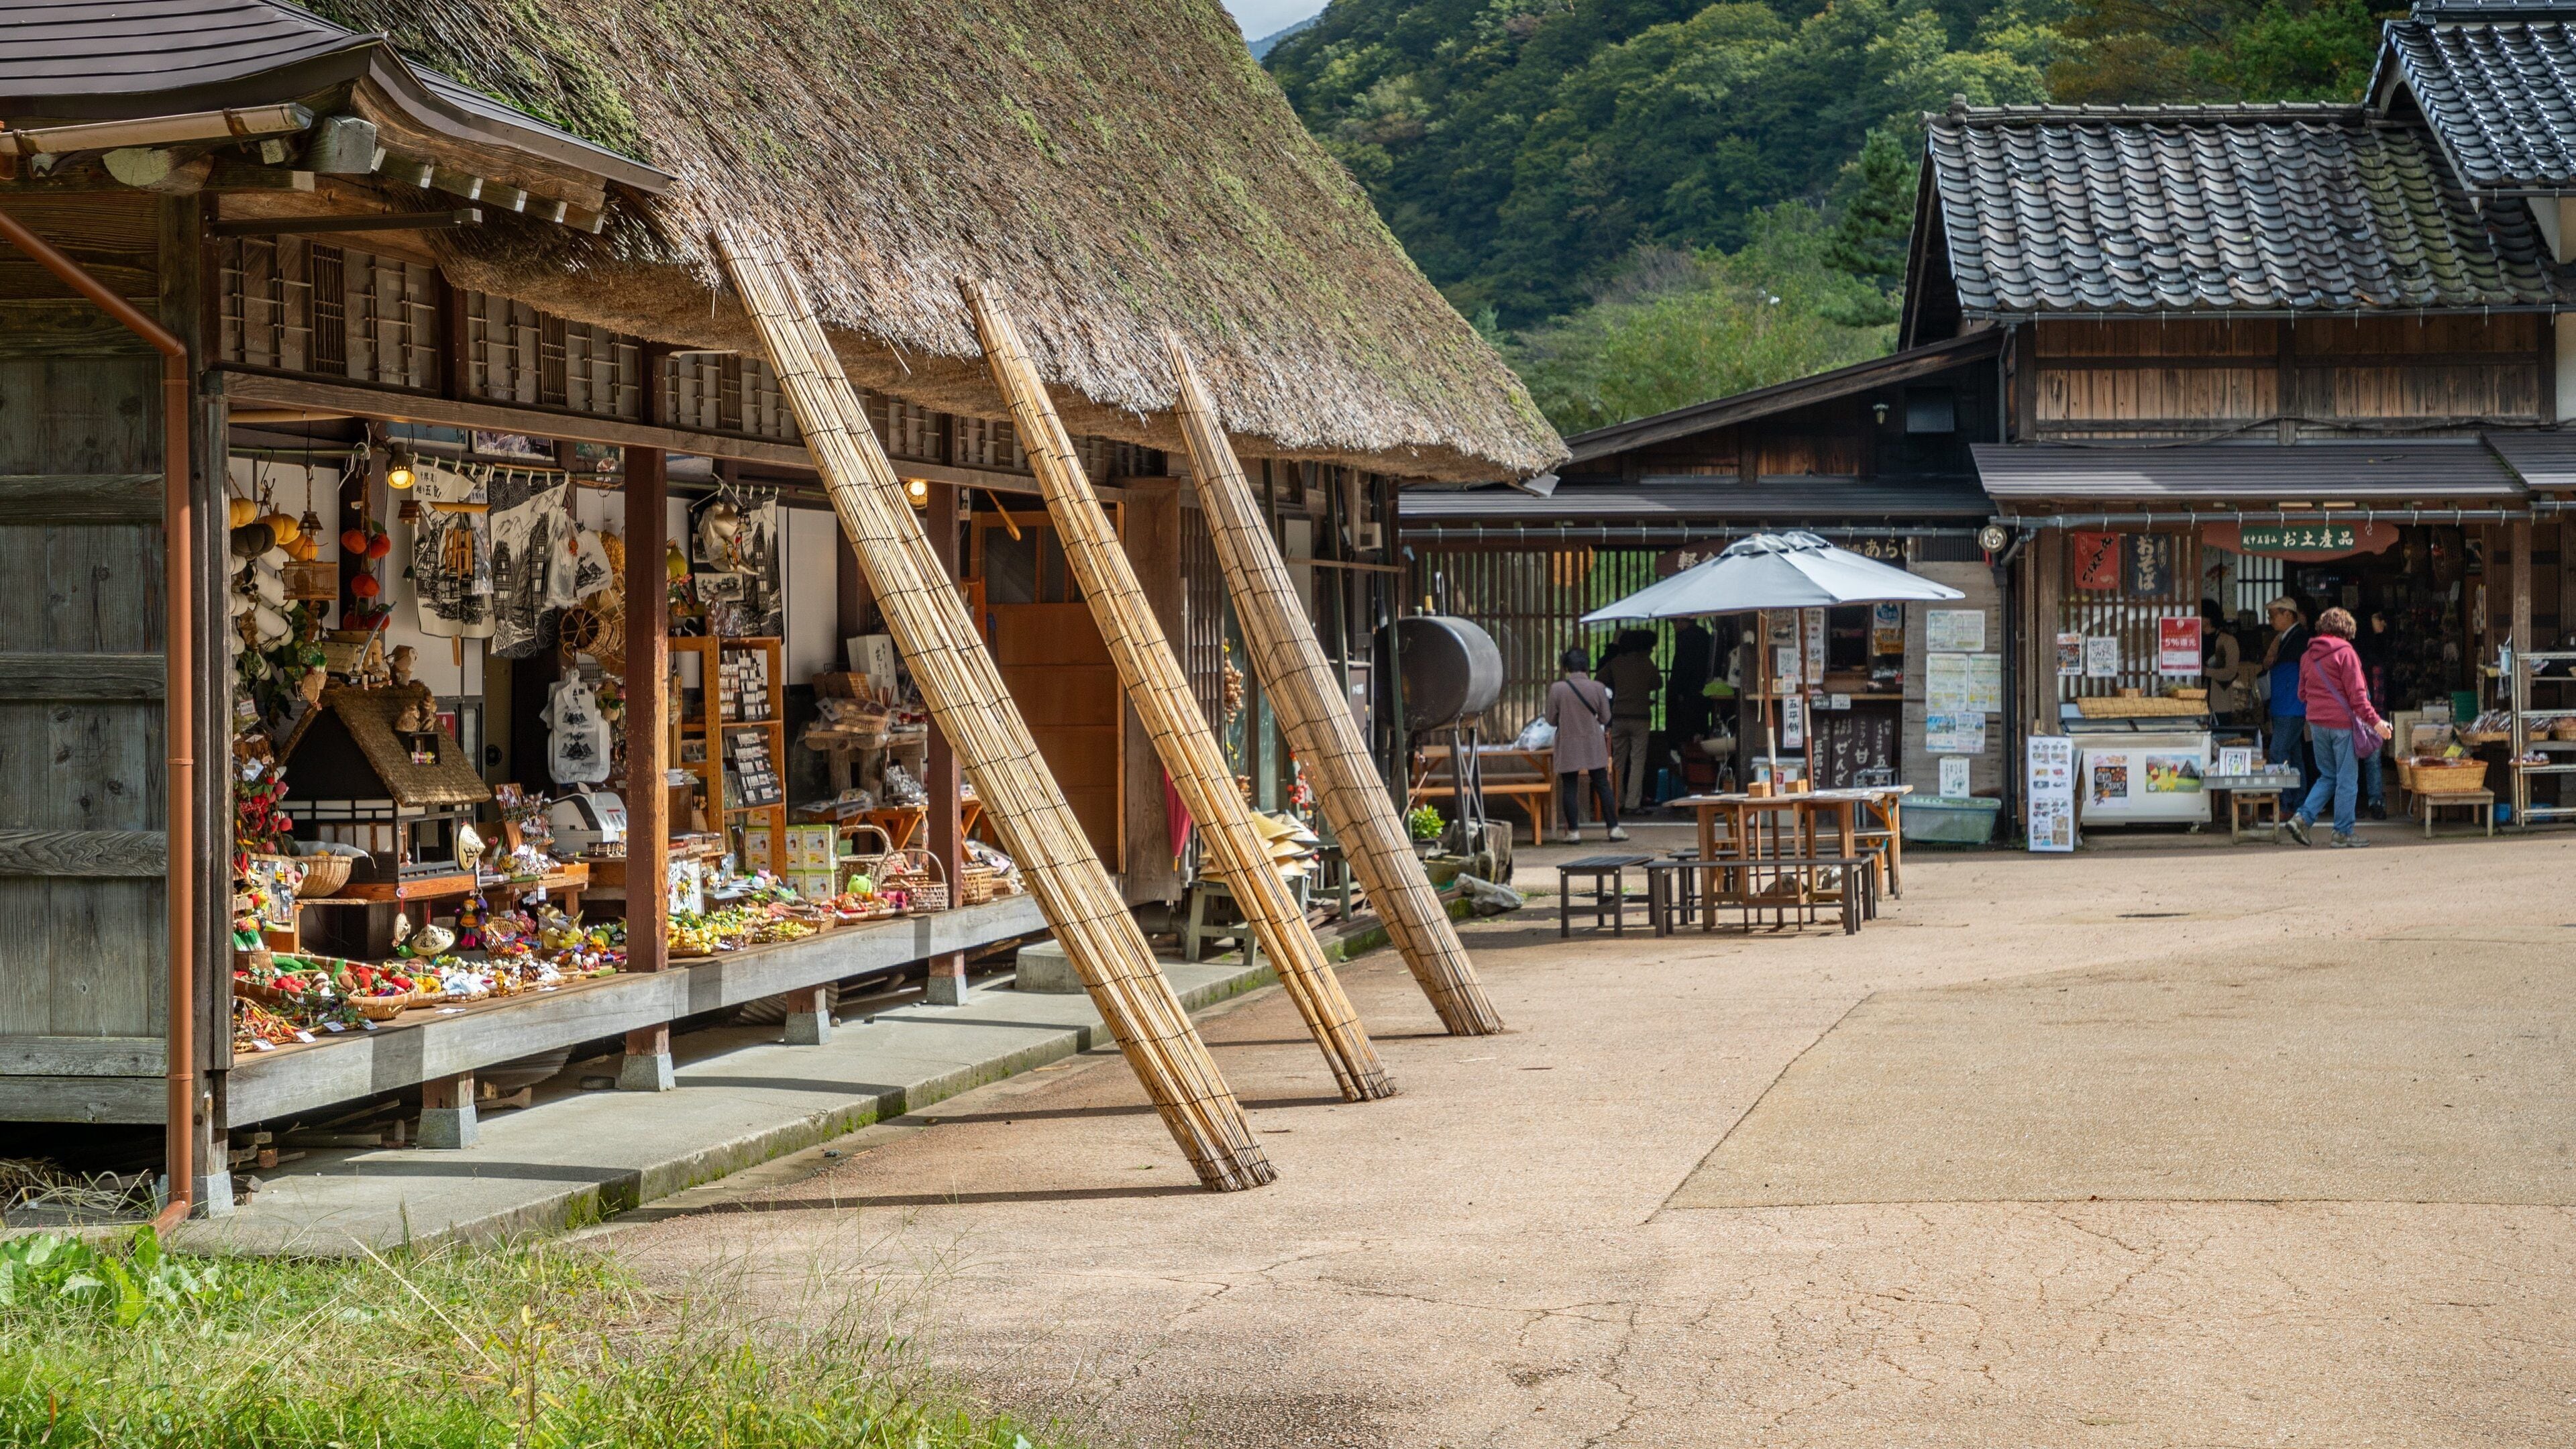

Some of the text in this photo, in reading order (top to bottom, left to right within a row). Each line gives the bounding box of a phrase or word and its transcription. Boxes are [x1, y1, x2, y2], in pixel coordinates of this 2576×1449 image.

[2283, 529, 2353, 547] お土産品
[2137, 535, 2157, 591] おそば
[1788, 699, 1799, 735] 五平餅
